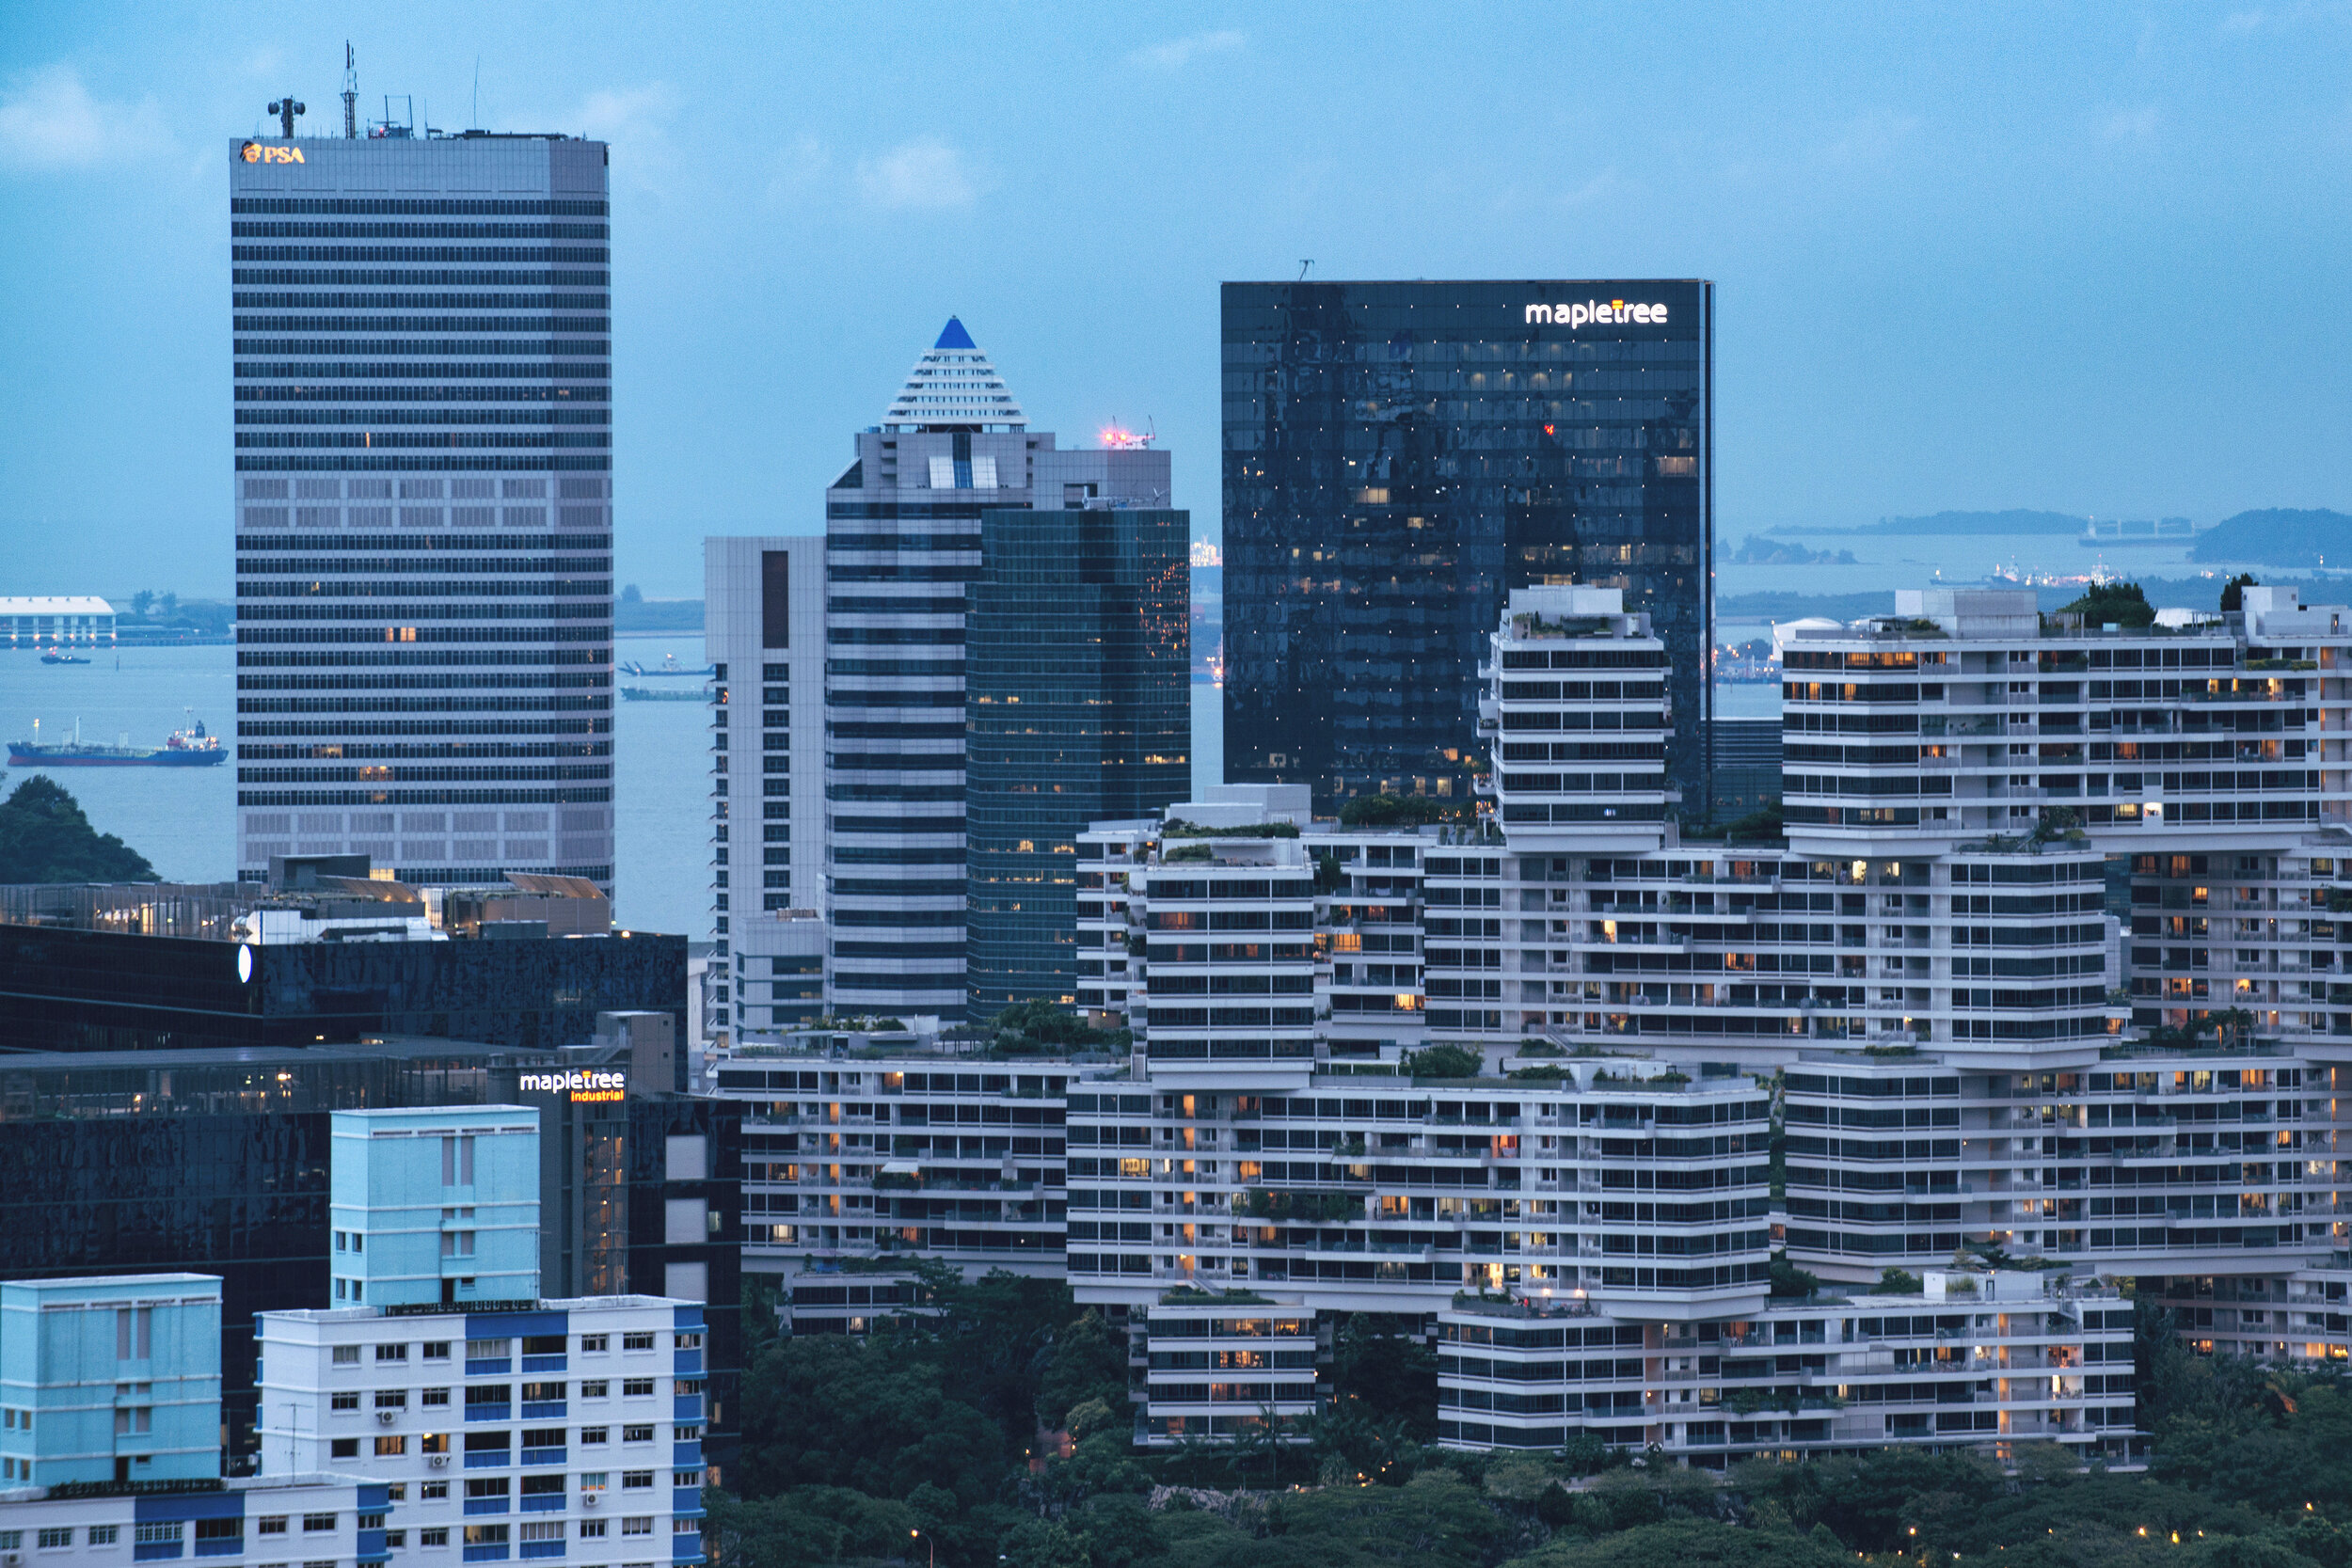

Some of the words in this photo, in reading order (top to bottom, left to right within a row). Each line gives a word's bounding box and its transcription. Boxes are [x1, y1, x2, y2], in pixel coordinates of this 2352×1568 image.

[264, 147, 305, 164] PSA
[1525, 299, 1668, 329] mapletree
[520, 1070, 625, 1094] mapletree
[570, 1089, 624, 1101] industrial
